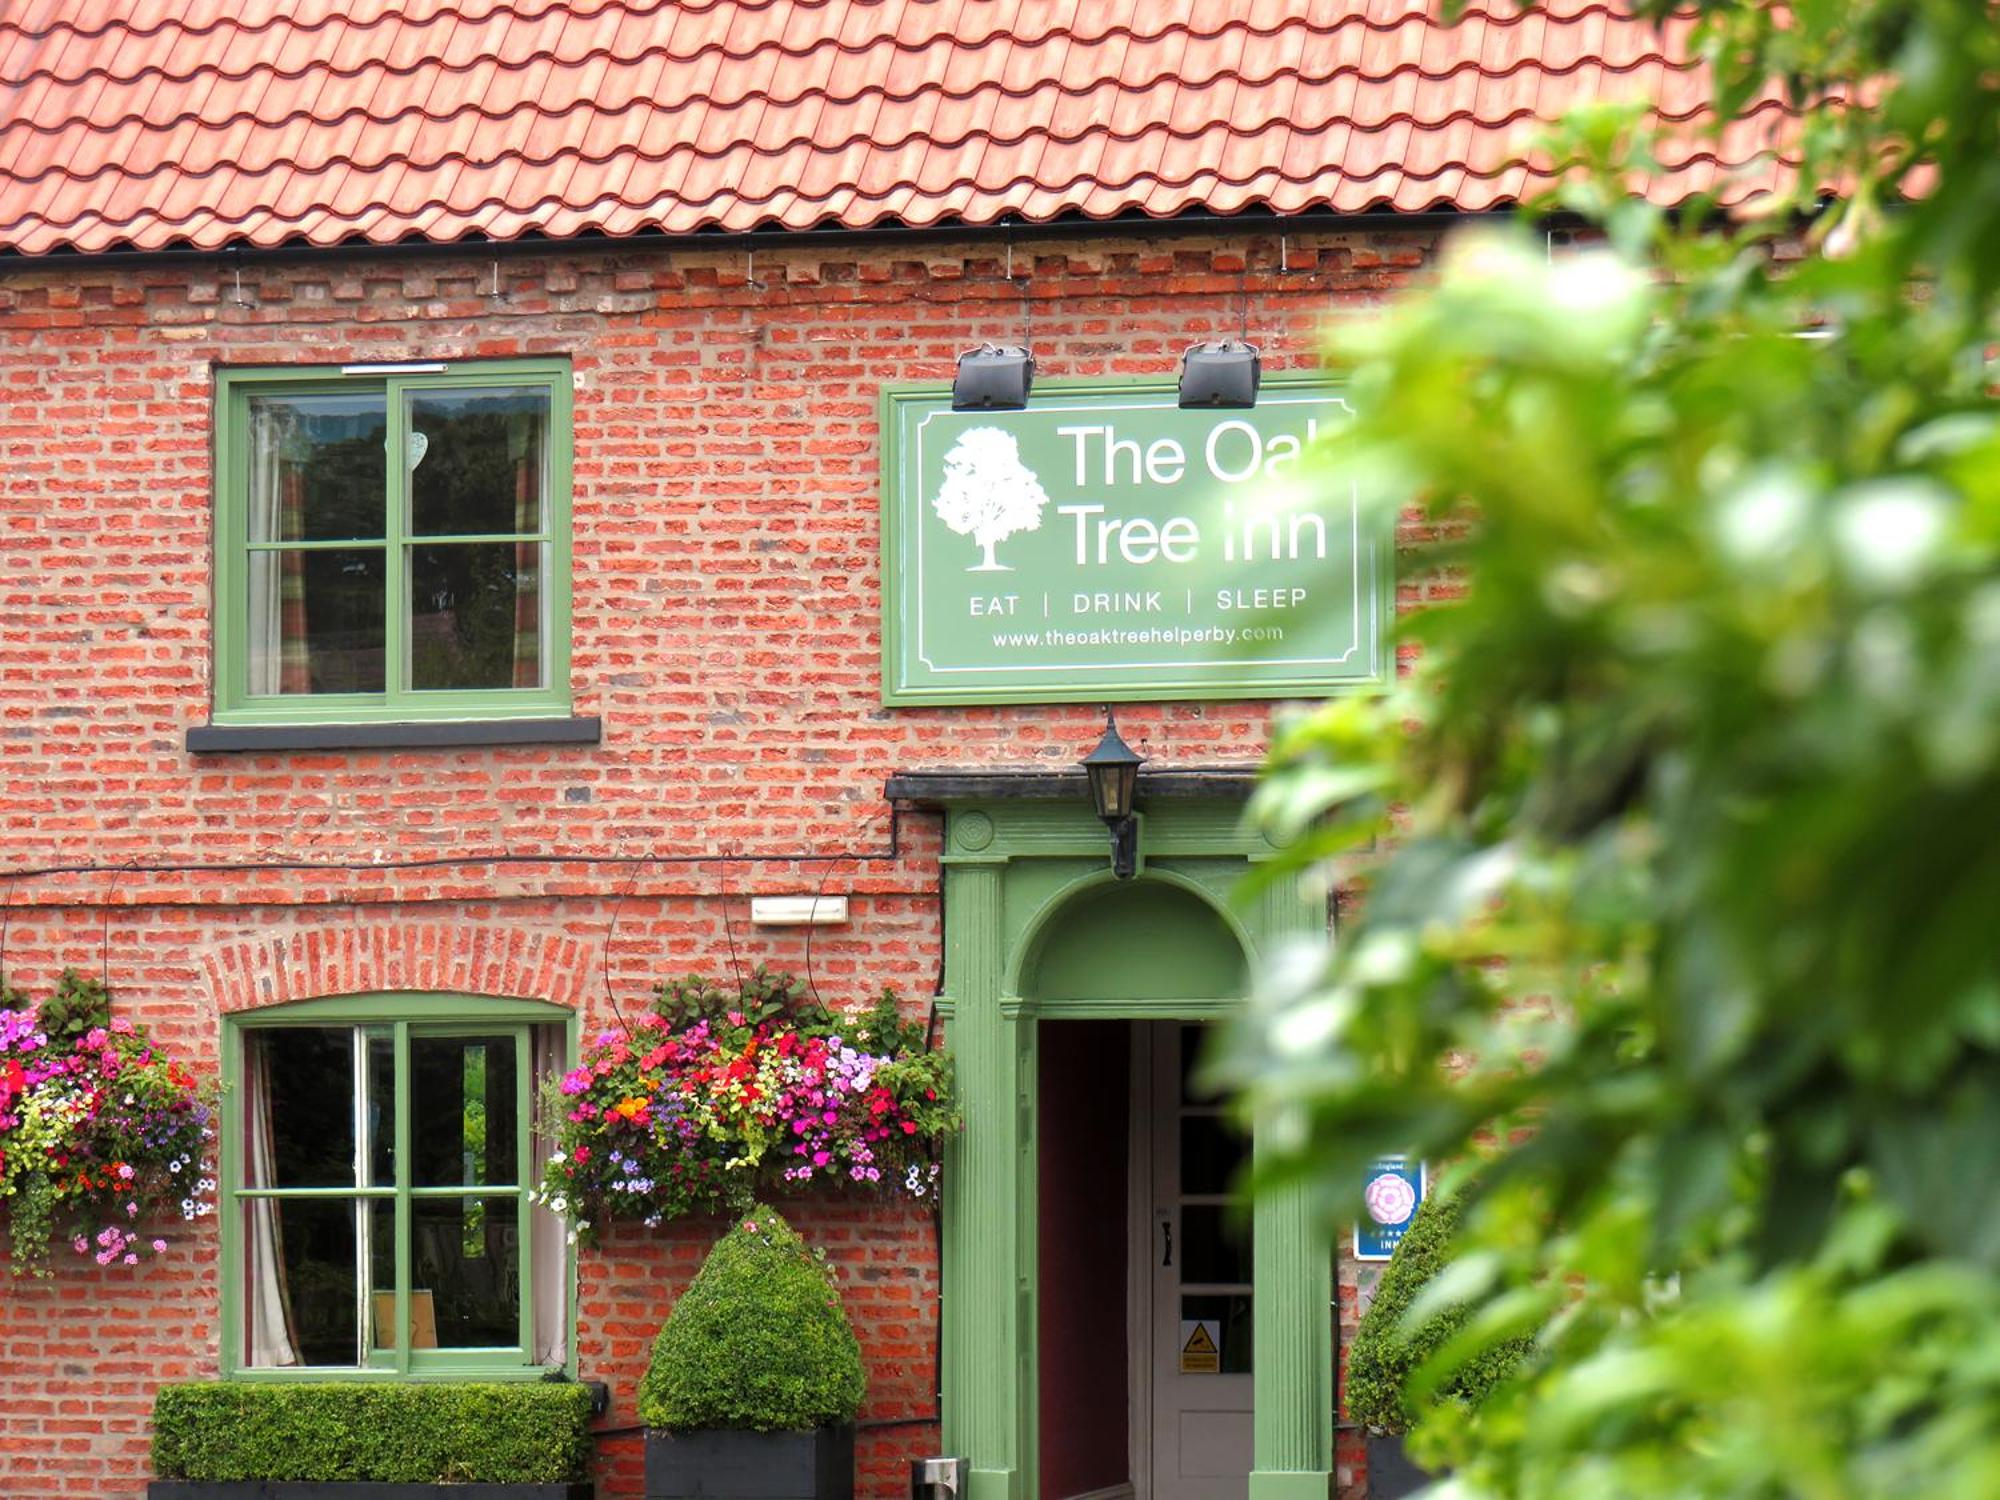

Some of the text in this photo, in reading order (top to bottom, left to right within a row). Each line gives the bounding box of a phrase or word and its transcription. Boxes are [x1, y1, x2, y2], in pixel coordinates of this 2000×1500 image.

[1057, 424, 1186, 487] The
[1057, 500, 1327, 565] Tree Inn
[969, 587, 1307, 616] EAT DRINK SLEEP
[992, 624, 1283, 648] www.theoaktreehelperby.com
